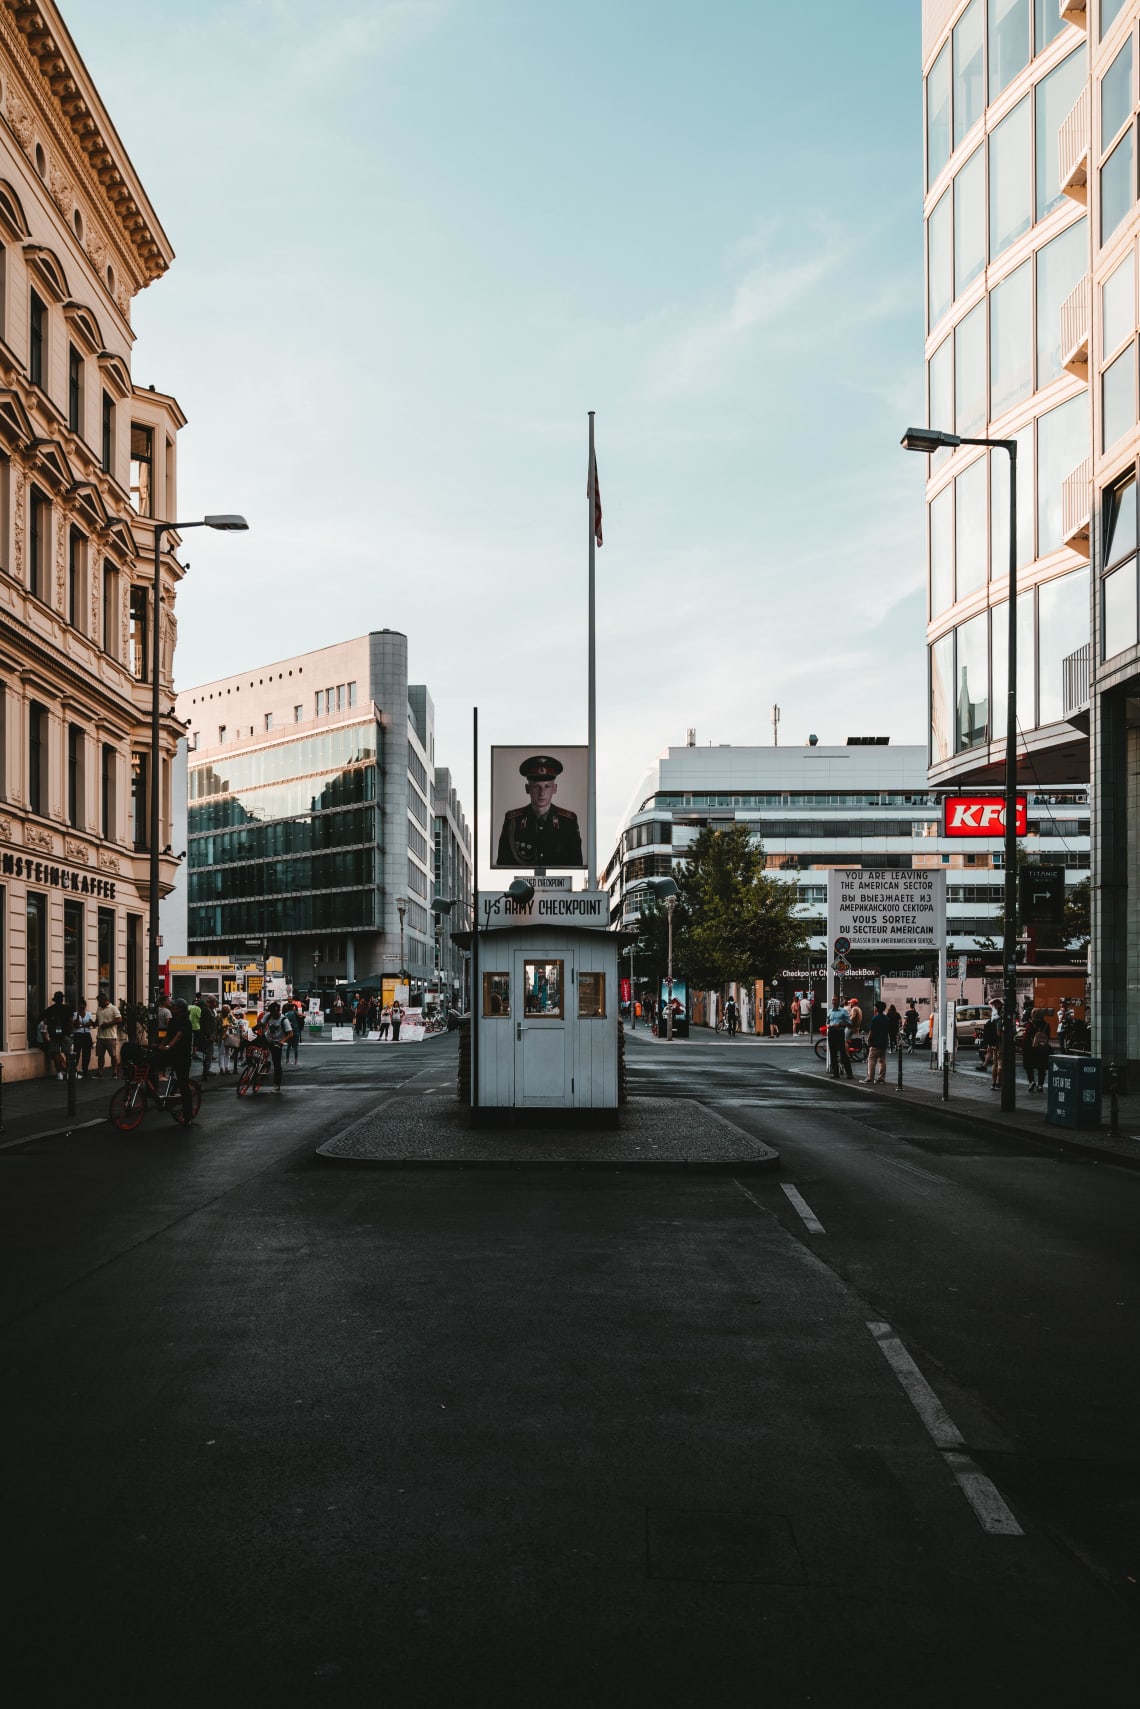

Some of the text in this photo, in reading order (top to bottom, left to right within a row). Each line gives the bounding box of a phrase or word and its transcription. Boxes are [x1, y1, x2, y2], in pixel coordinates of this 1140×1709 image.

[949, 804, 1023, 827] KFC
[845, 871, 928, 880] YOU ARE LEAVING
[71, 872, 116, 899] KAFFEE
[538, 878, 565, 888] CHECKPOINT
[840, 881, 933, 890] THE AMERICAN SECTOR
[841, 894, 932, 902] ВЫ ВЫЕЗЖАЕТЕ ИЗ
[505, 899, 534, 915] ARMY
[539, 899, 602, 915] CHECKPOINT
[840, 903, 934, 912] АМЕРИКАНСКОГО СЕКТОРА
[852, 915, 917, 924] VOUS SORTEZ
[840, 925, 850, 934] DU
[853, 925, 887, 934] SECTEUR
[782, 970, 817, 978] Checkpont
